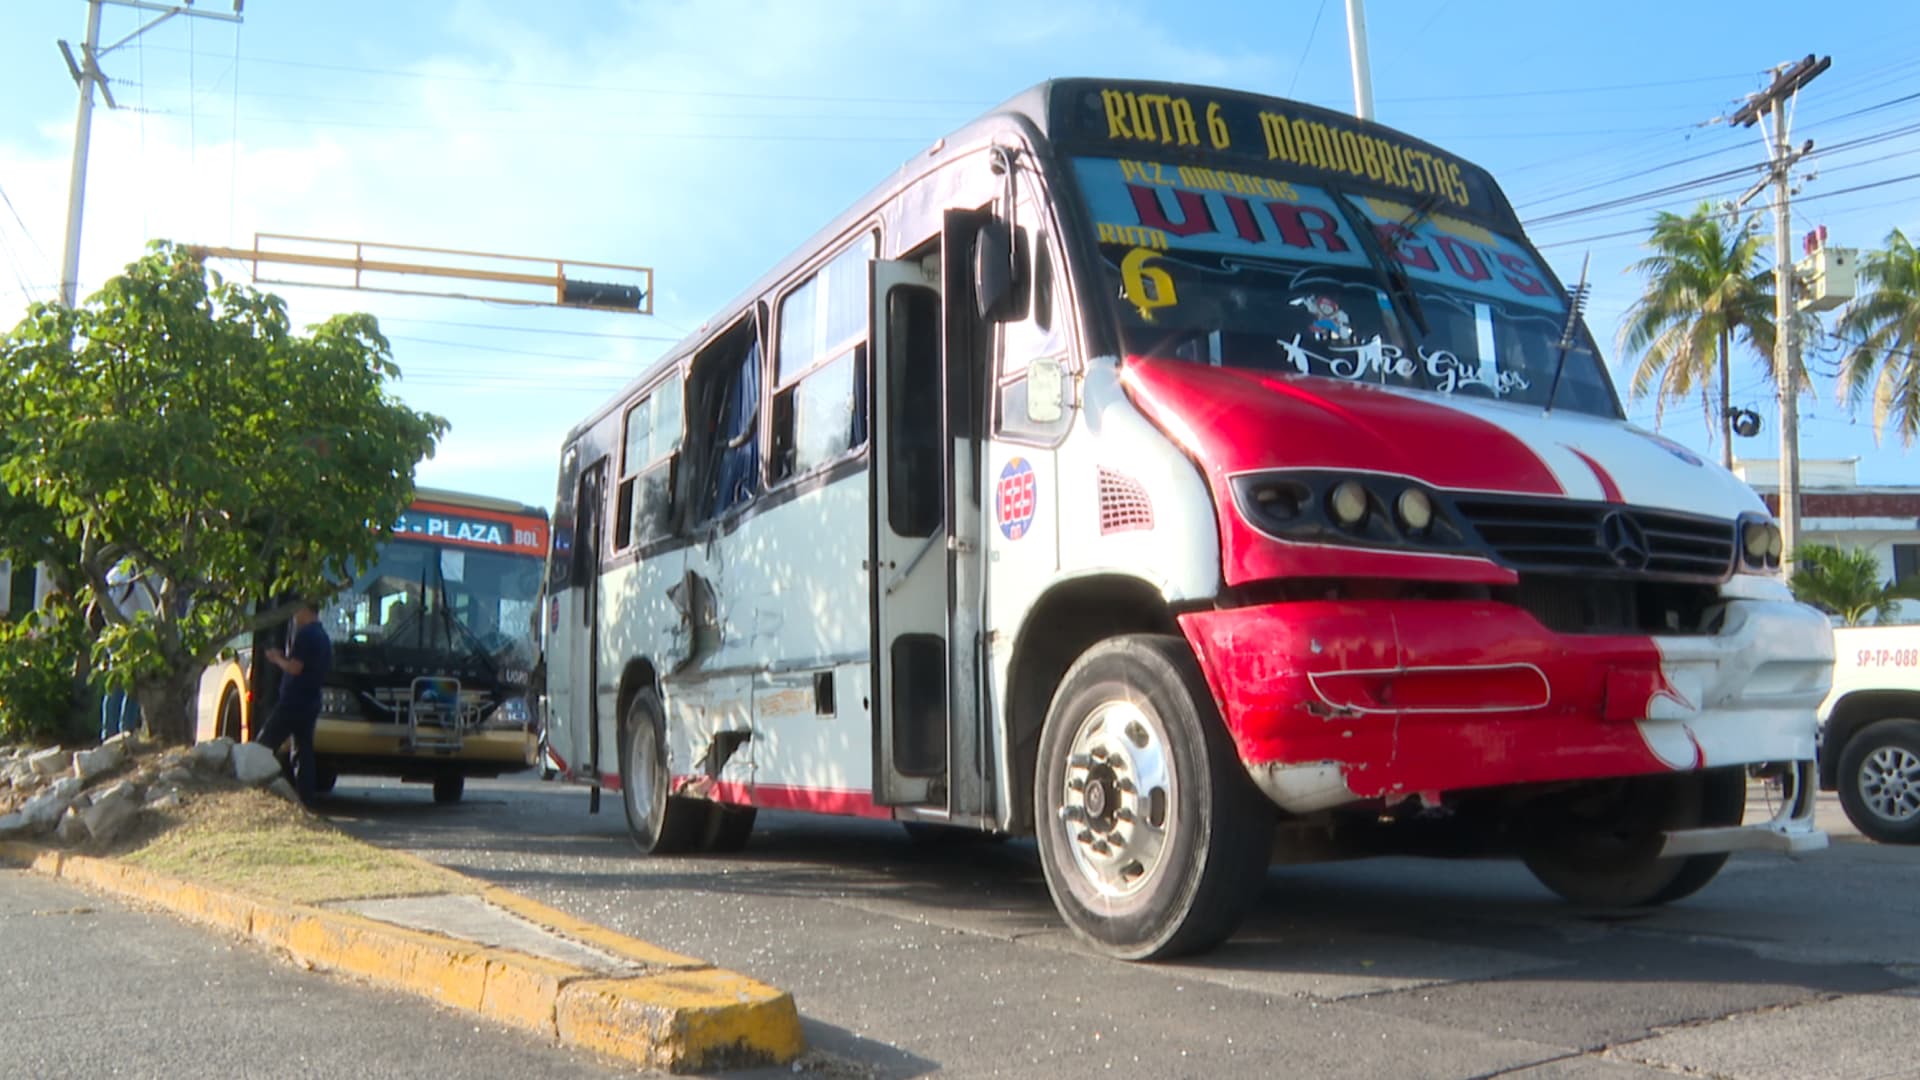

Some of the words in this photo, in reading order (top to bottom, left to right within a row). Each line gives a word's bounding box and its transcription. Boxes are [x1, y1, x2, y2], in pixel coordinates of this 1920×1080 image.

[1101, 89, 1200, 146] RUTA
[1206, 102, 1230, 149] 6
[1259, 111, 1469, 206] MANIOBRISTAS
[1178, 165, 1299, 200] AMERICAS
[1097, 222, 1169, 250] RUTA
[1121, 247, 1177, 309] 6
[427, 518, 503, 545] PLAZA
[514, 529, 539, 548] BOL
